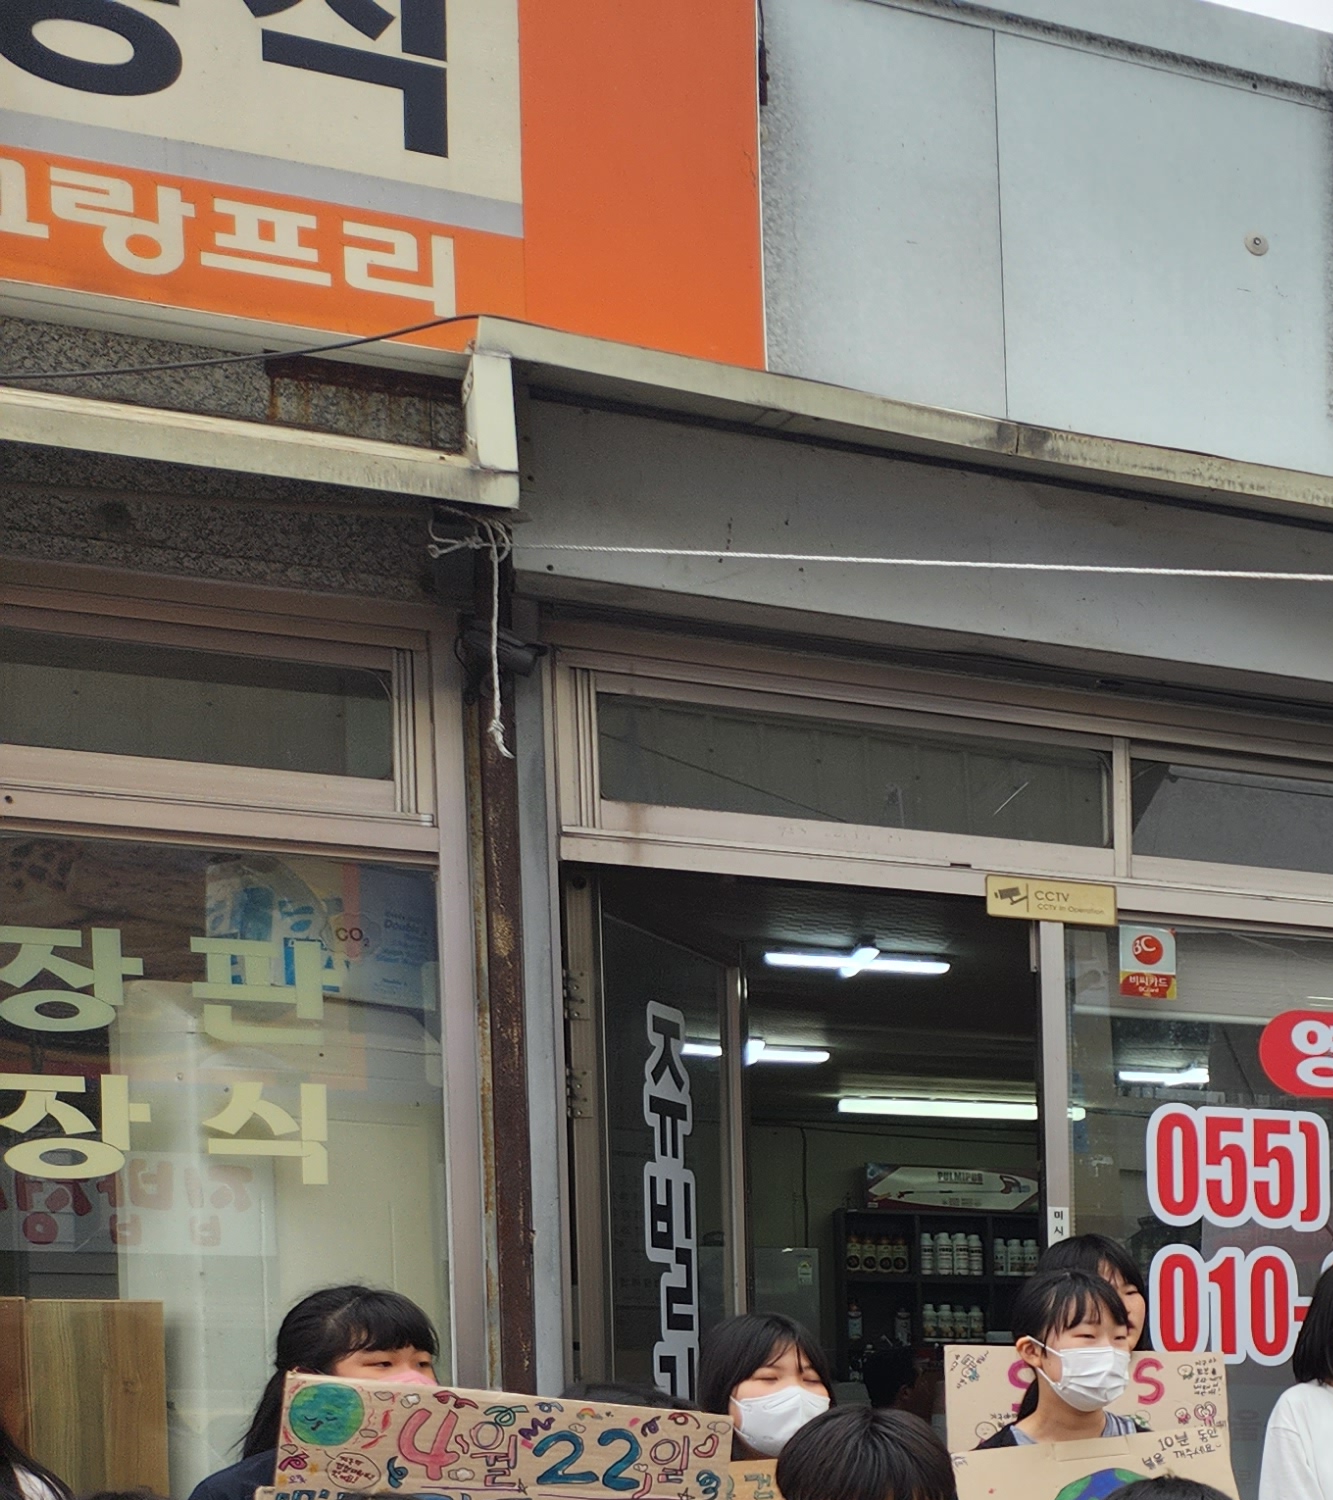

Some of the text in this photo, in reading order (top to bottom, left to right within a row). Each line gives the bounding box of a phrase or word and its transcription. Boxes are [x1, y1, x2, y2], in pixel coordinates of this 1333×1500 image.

[1033, 890, 1071, 903] CCTV
[1129, 974, 1169, 988] 비씨카드
[1153, 1109, 1321, 1226] 055)
[397, 1406, 517, 1488] 4월
